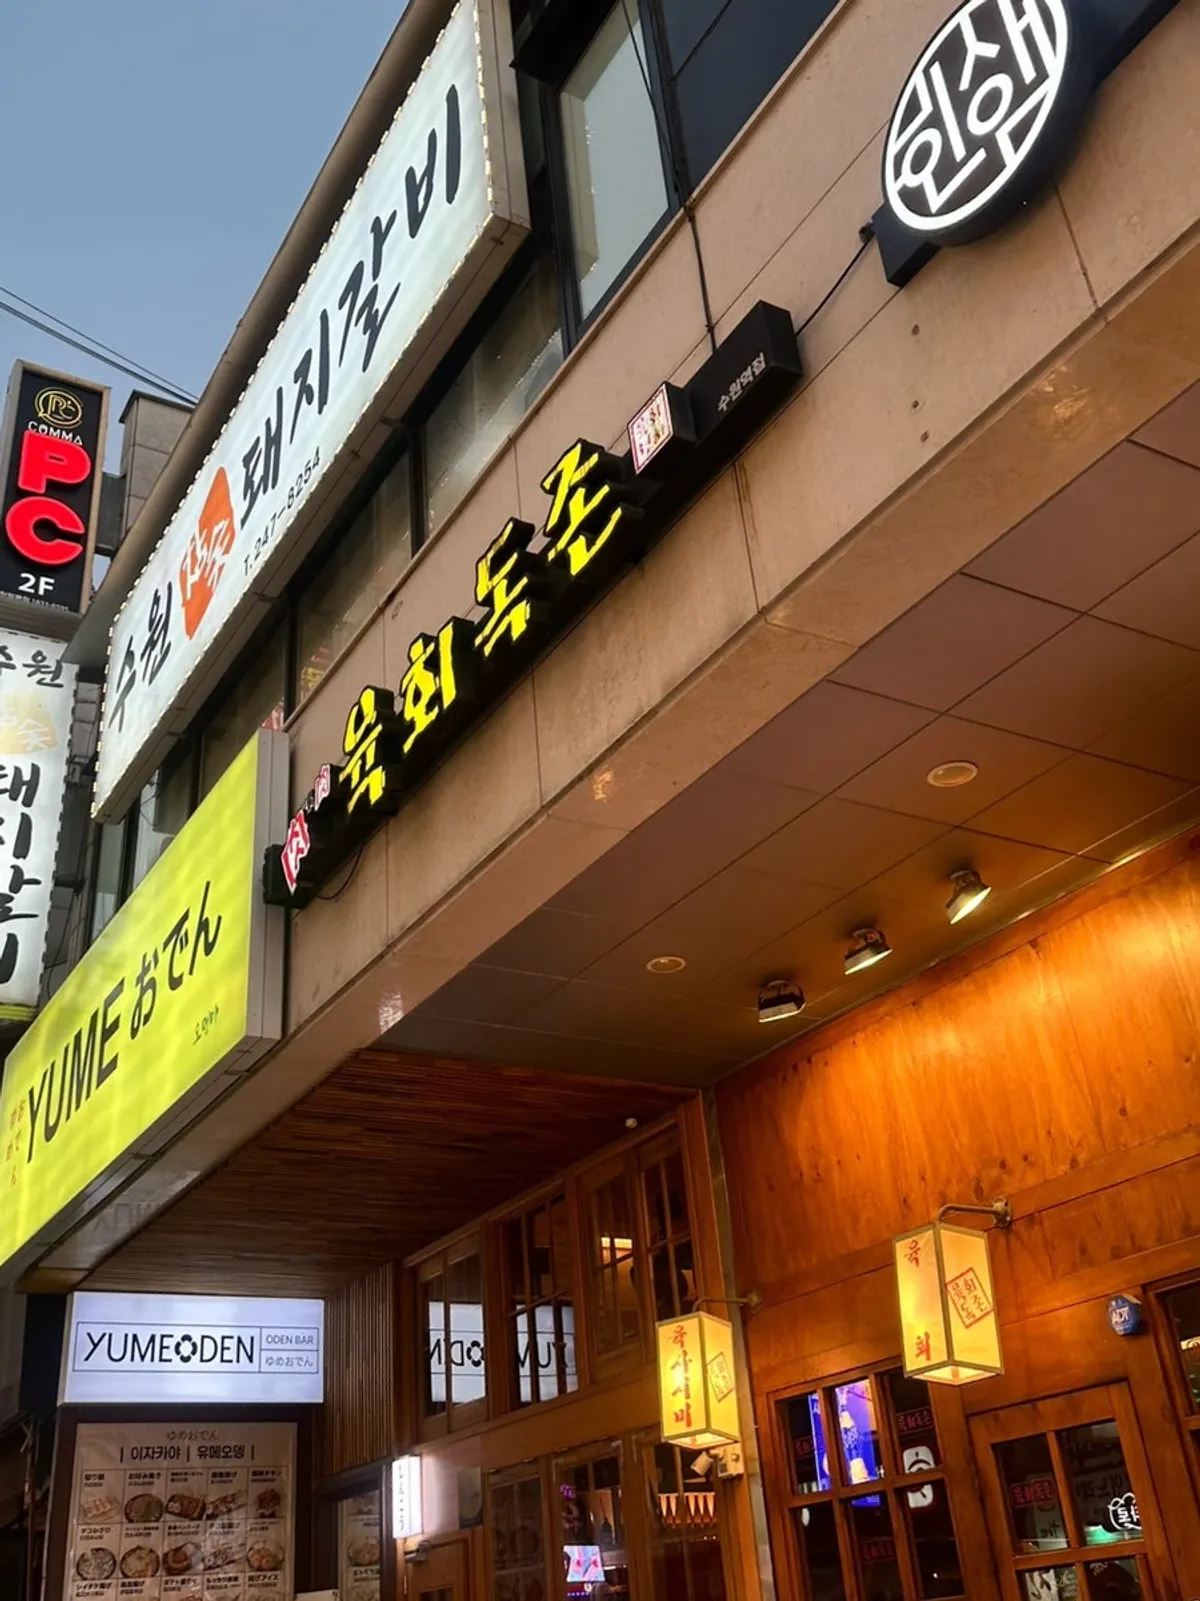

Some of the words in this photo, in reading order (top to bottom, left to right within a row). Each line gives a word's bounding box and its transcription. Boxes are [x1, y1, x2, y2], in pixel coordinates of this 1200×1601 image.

[28, 421, 83, 446] COMMA
[108, 580, 172, 732] 수원
[241, 84, 461, 530] 돼지갈비
[6, 430, 92, 566] PC
[18, 573, 55, 596] 2F
[27, 976, 126, 1163] YUME
[130, 880, 222, 1041] おでん
[266, 1334, 293, 1344] ODEN
[294, 1335, 314, 1345] BAR
[669, 1324, 692, 1429] 육사시미
[130, 1445, 181, 1461] 이자카야
[196, 1444, 246, 1460] 유메오뎅
